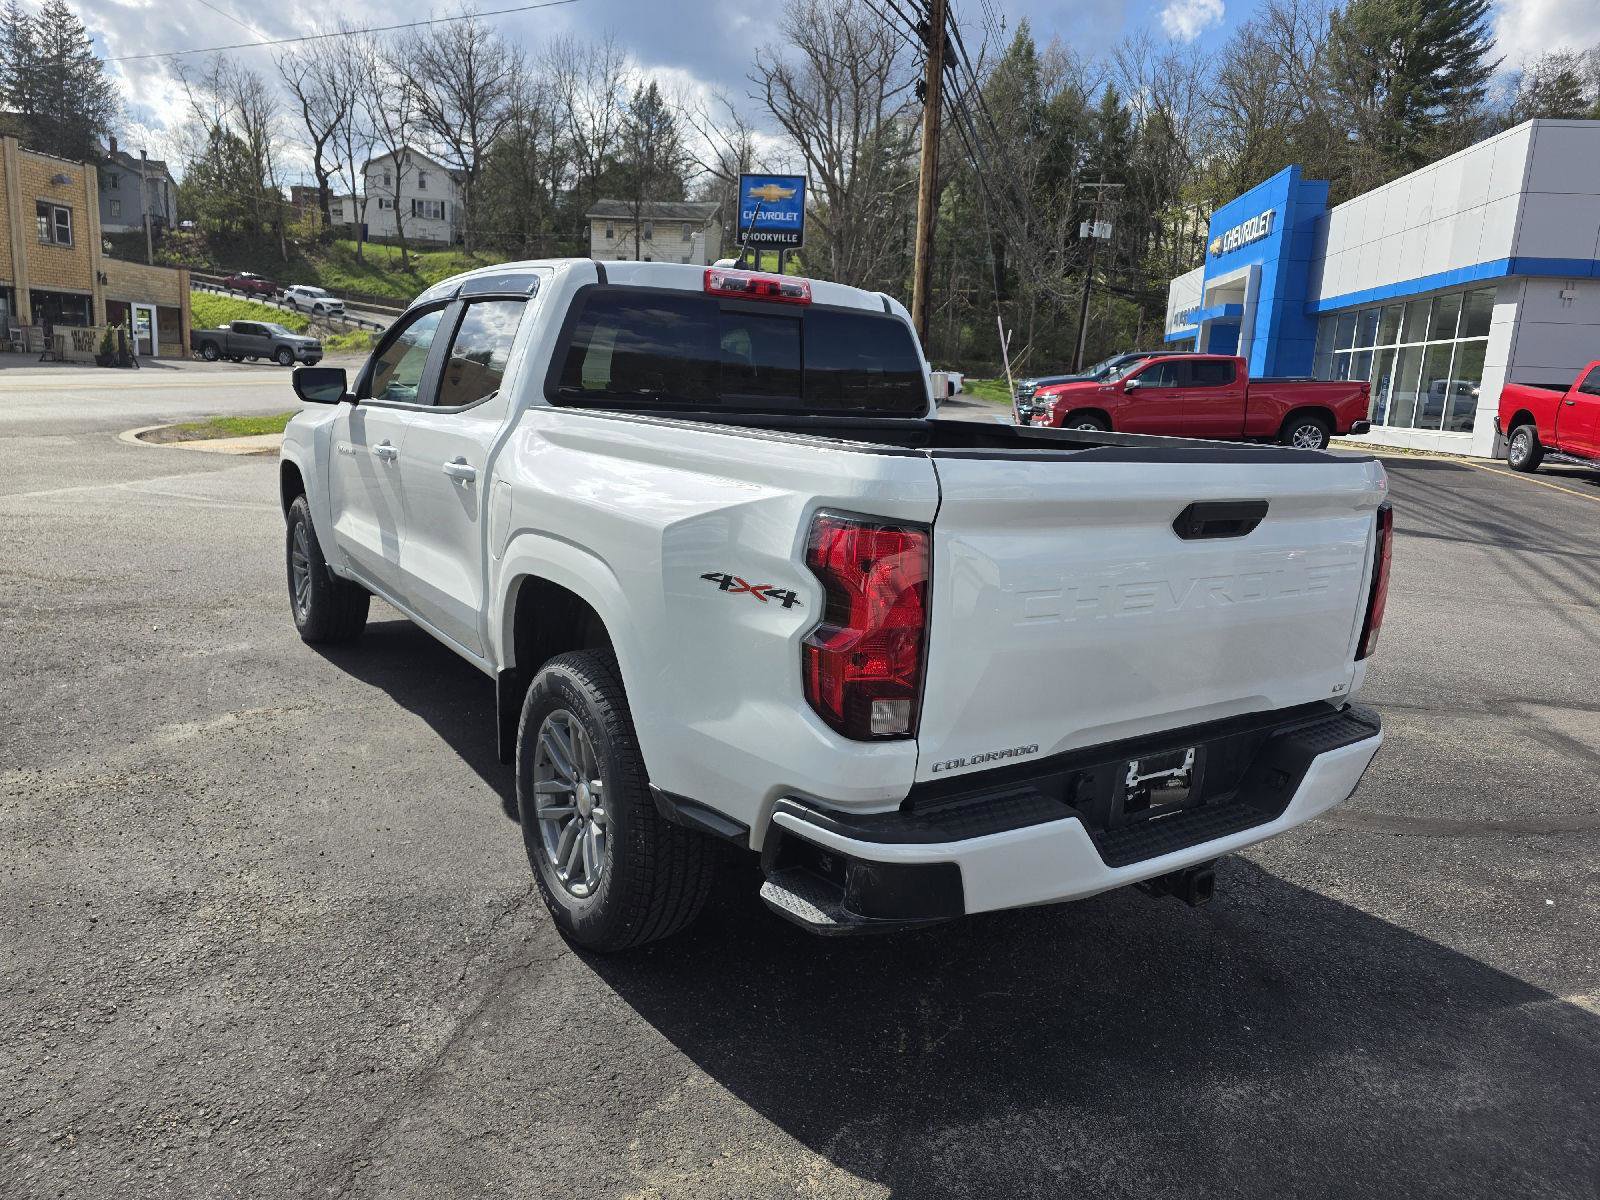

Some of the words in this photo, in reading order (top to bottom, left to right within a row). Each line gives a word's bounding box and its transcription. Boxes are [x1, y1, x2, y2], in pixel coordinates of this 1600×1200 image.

[743, 210, 798, 221] CHEVROLET
[1223, 208, 1275, 252] CHEVROLET
[741, 232, 798, 243] BROOKVILLE
[1014, 562, 1358, 627] CHEVROLET
[932, 743, 1039, 773] COLORADO
